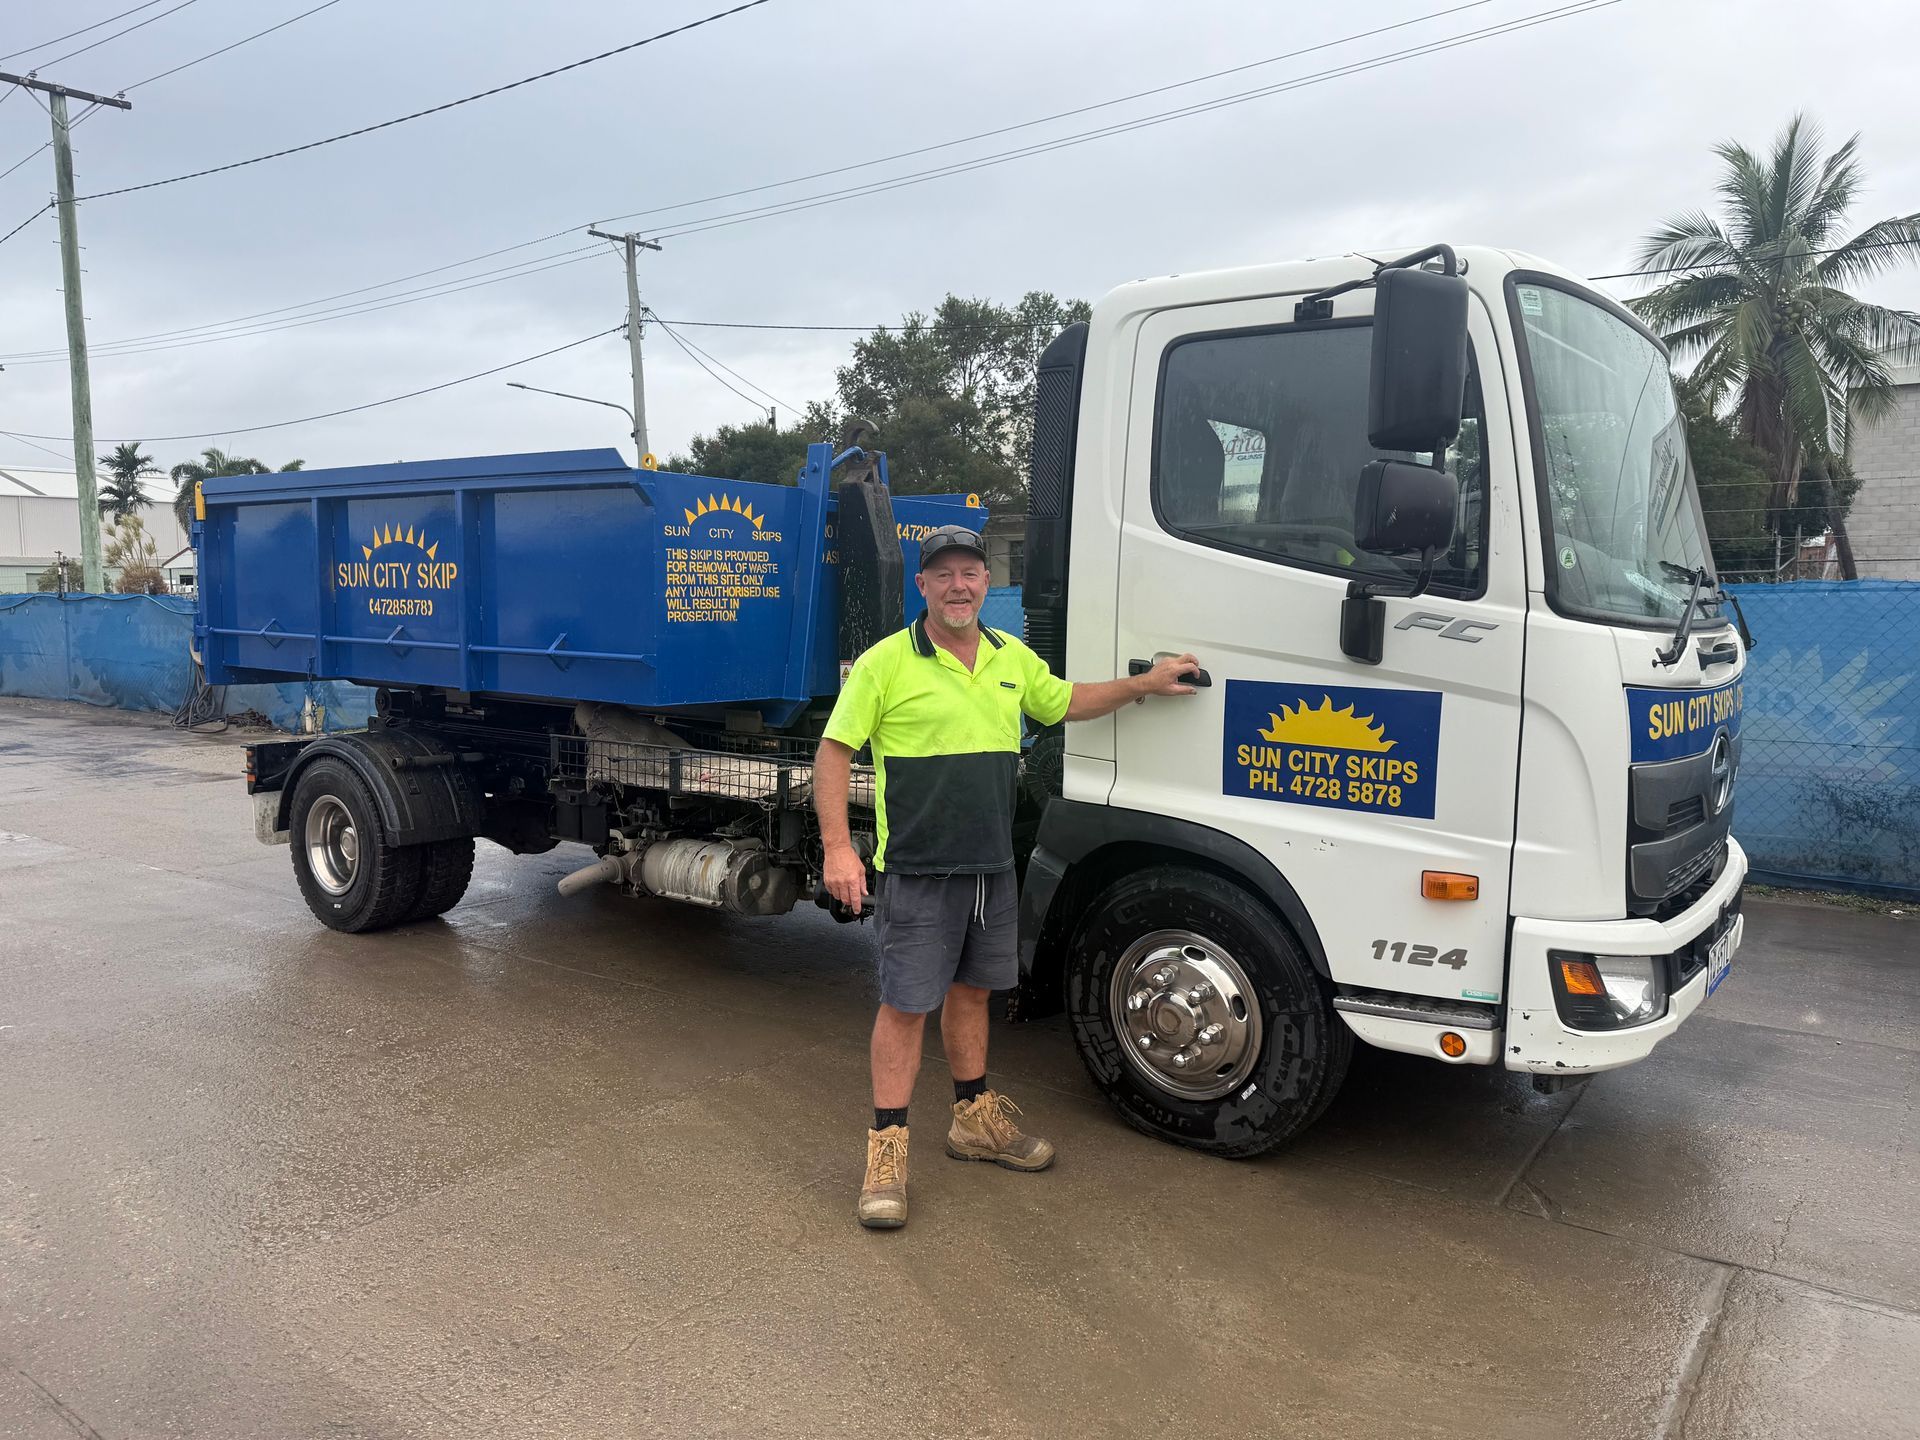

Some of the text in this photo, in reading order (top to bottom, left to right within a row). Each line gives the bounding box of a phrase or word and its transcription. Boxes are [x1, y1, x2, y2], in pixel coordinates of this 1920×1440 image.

[664, 525, 782, 542] SUN CITY SKIPS
[665, 548, 769, 562] THIS SKIP IS PROVIDED
[338, 562, 458, 589] SUN CITY SKIP
[666, 561, 778, 574] FOR REMOVAL OF WASTE
[666, 574, 764, 586] FROM THIS SITE ONLY
[665, 586, 780, 598] ANY UNAUTHORISED USE
[666, 598, 740, 610] WILL RESULT IN
[667, 610, 738, 622] PROSECUTION.
[1394, 611, 1500, 644] FC
[1648, 700, 1684, 741] SUN
[1687, 694, 1711, 732] CITY
[1713, 687, 1734, 724] SKIPS
[1237, 744, 1418, 784] SUN CITY SKIPS
[1249, 769, 1402, 808] PH. 4728 5878
[1371, 939, 1468, 970] 1124
